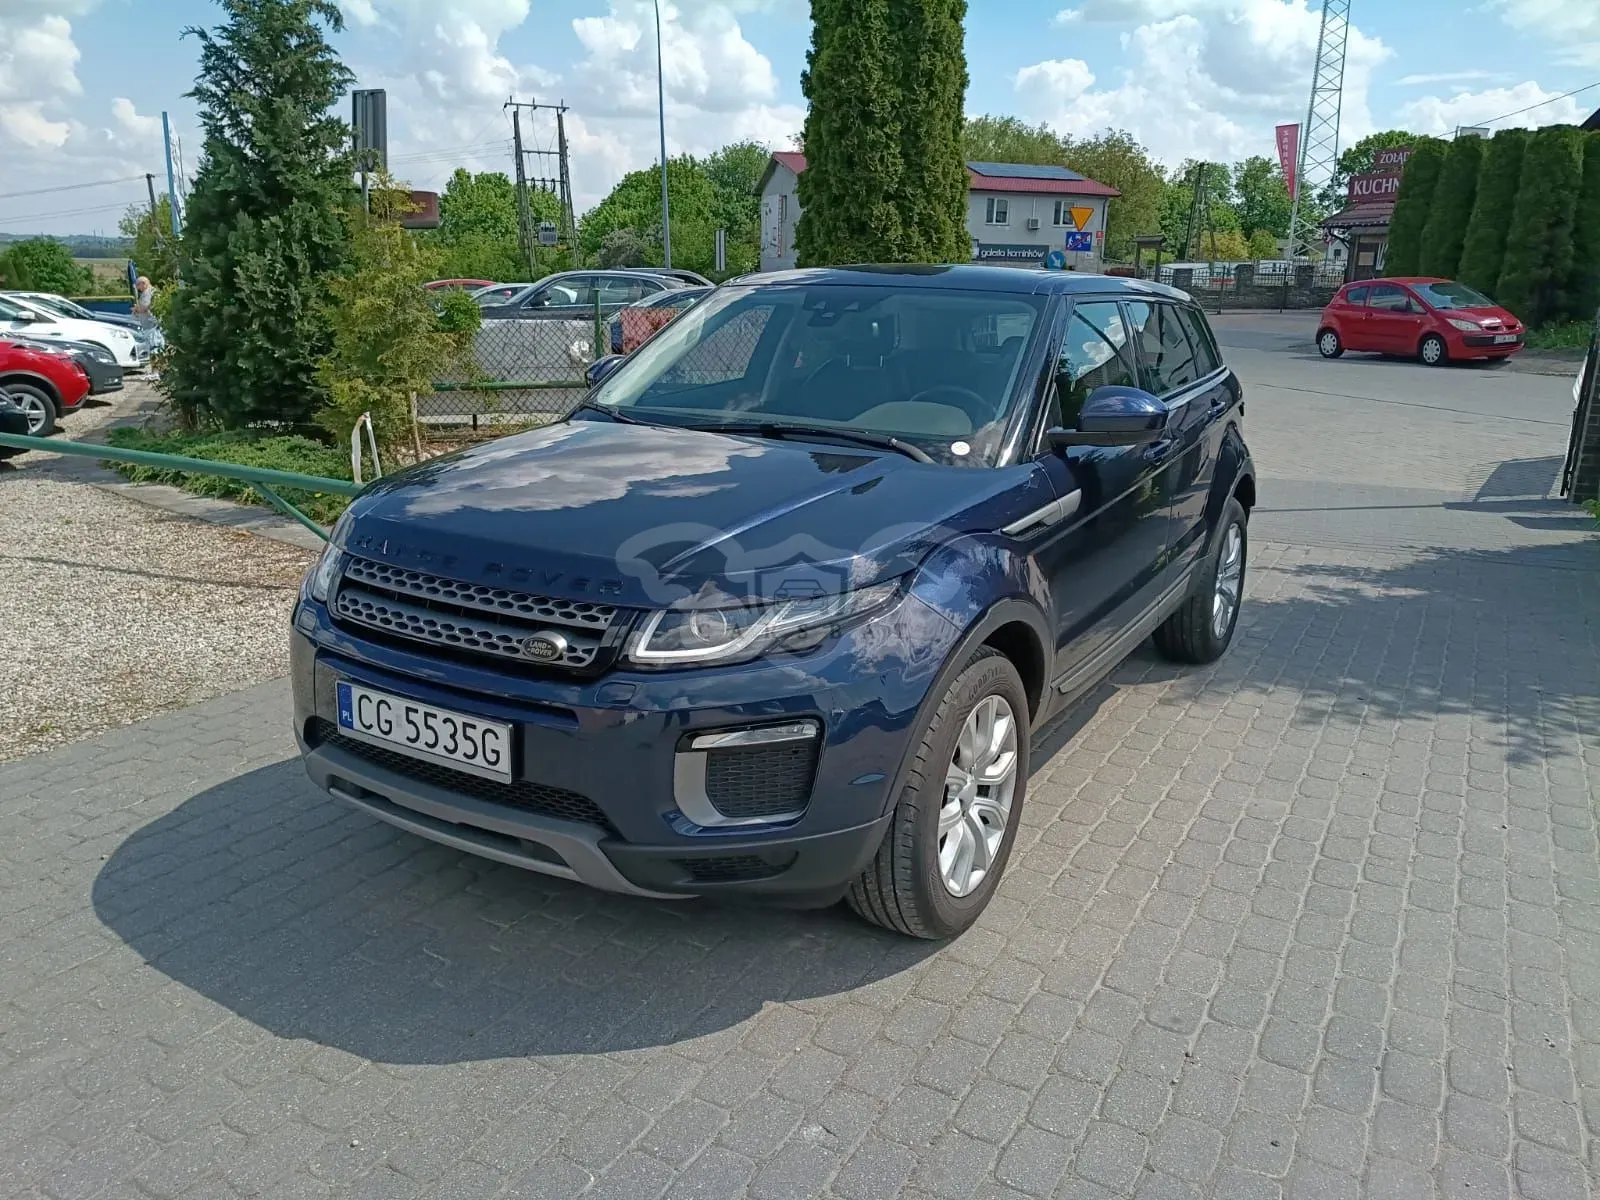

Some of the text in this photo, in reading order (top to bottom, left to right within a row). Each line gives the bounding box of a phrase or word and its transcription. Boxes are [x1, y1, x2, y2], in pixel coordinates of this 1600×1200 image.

[483, 561, 624, 594] ROVER
[530, 640, 547, 649] LAND
[530, 648, 552, 656] ROVER
[342, 710, 352, 722] PL
[358, 694, 501, 766] CG 5535G
